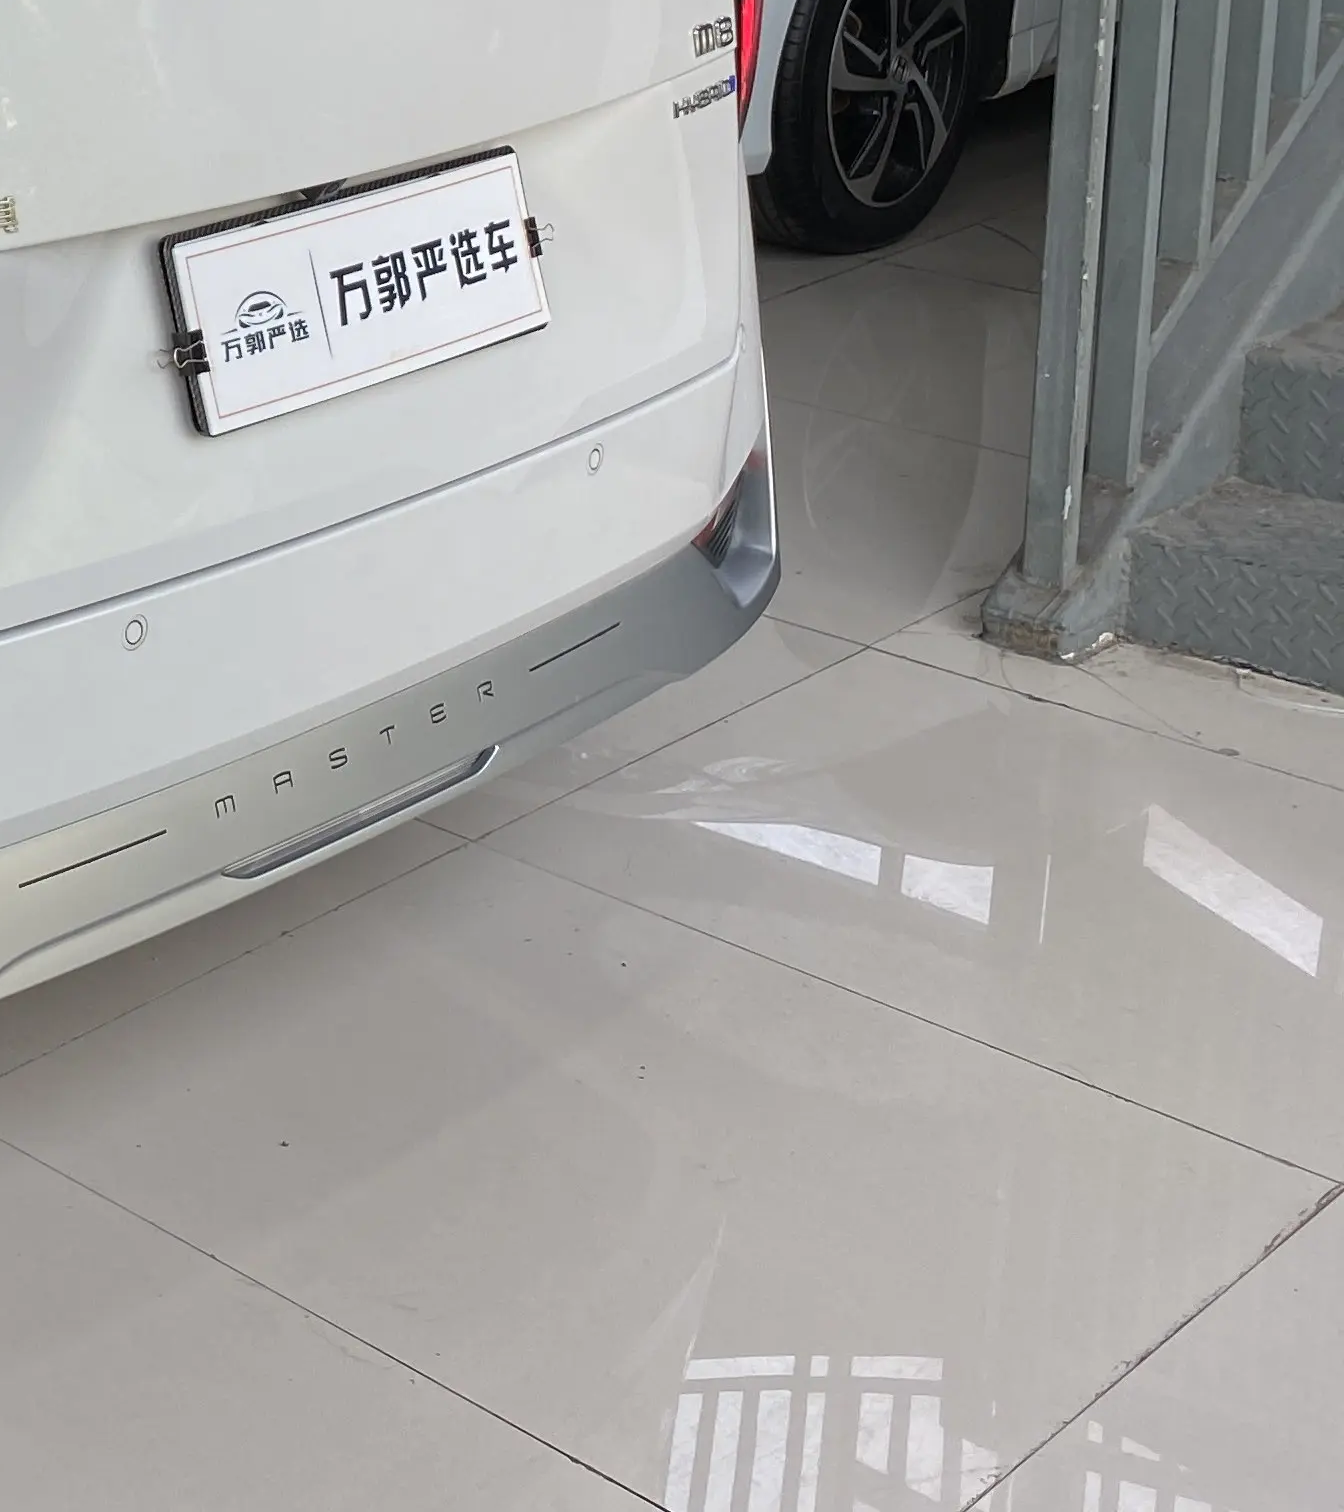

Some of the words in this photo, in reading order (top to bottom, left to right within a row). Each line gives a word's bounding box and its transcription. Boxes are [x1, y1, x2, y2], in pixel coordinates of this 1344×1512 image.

[329, 219, 518, 327] 万郭严选车
[220, 318, 310, 363] 万郭严选
[214, 680, 495, 819] MASTER
